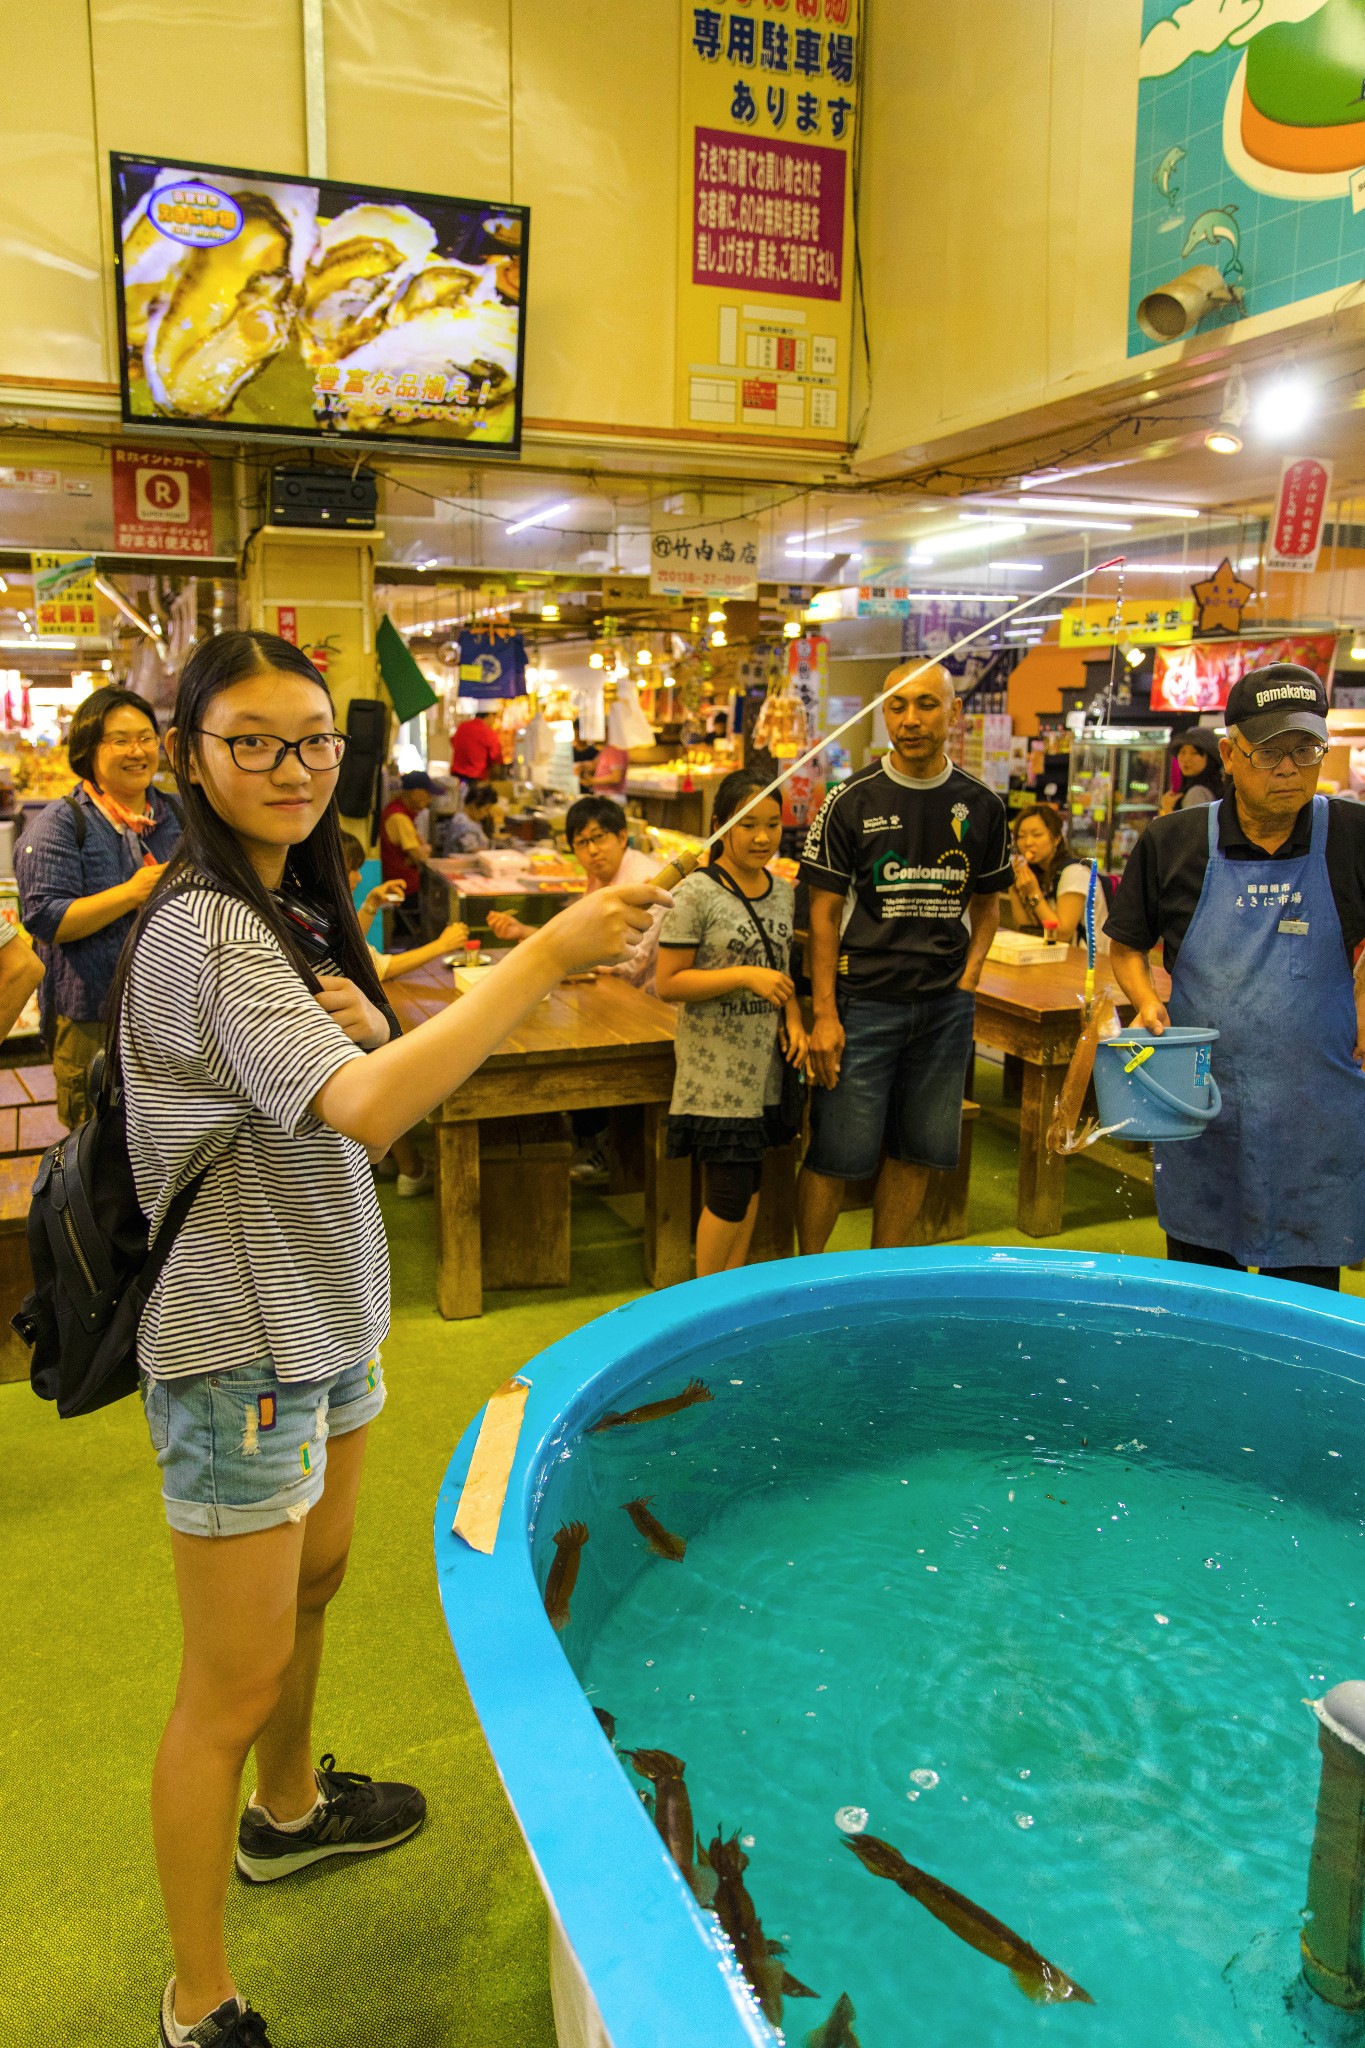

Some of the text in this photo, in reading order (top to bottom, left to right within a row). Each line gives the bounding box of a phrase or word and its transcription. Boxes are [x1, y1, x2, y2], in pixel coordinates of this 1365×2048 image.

[693, 8, 853, 83] 専用駐車場
[731, 80, 852, 137] あります
[698, 141, 822, 198] えきに市場でお買い物された
[155, 481, 173, 504] R
[1256, 683, 1317, 708] gamakatsu
[1236, 892, 1303, 908] えきに市場
[318, 1815, 355, 1841] N
